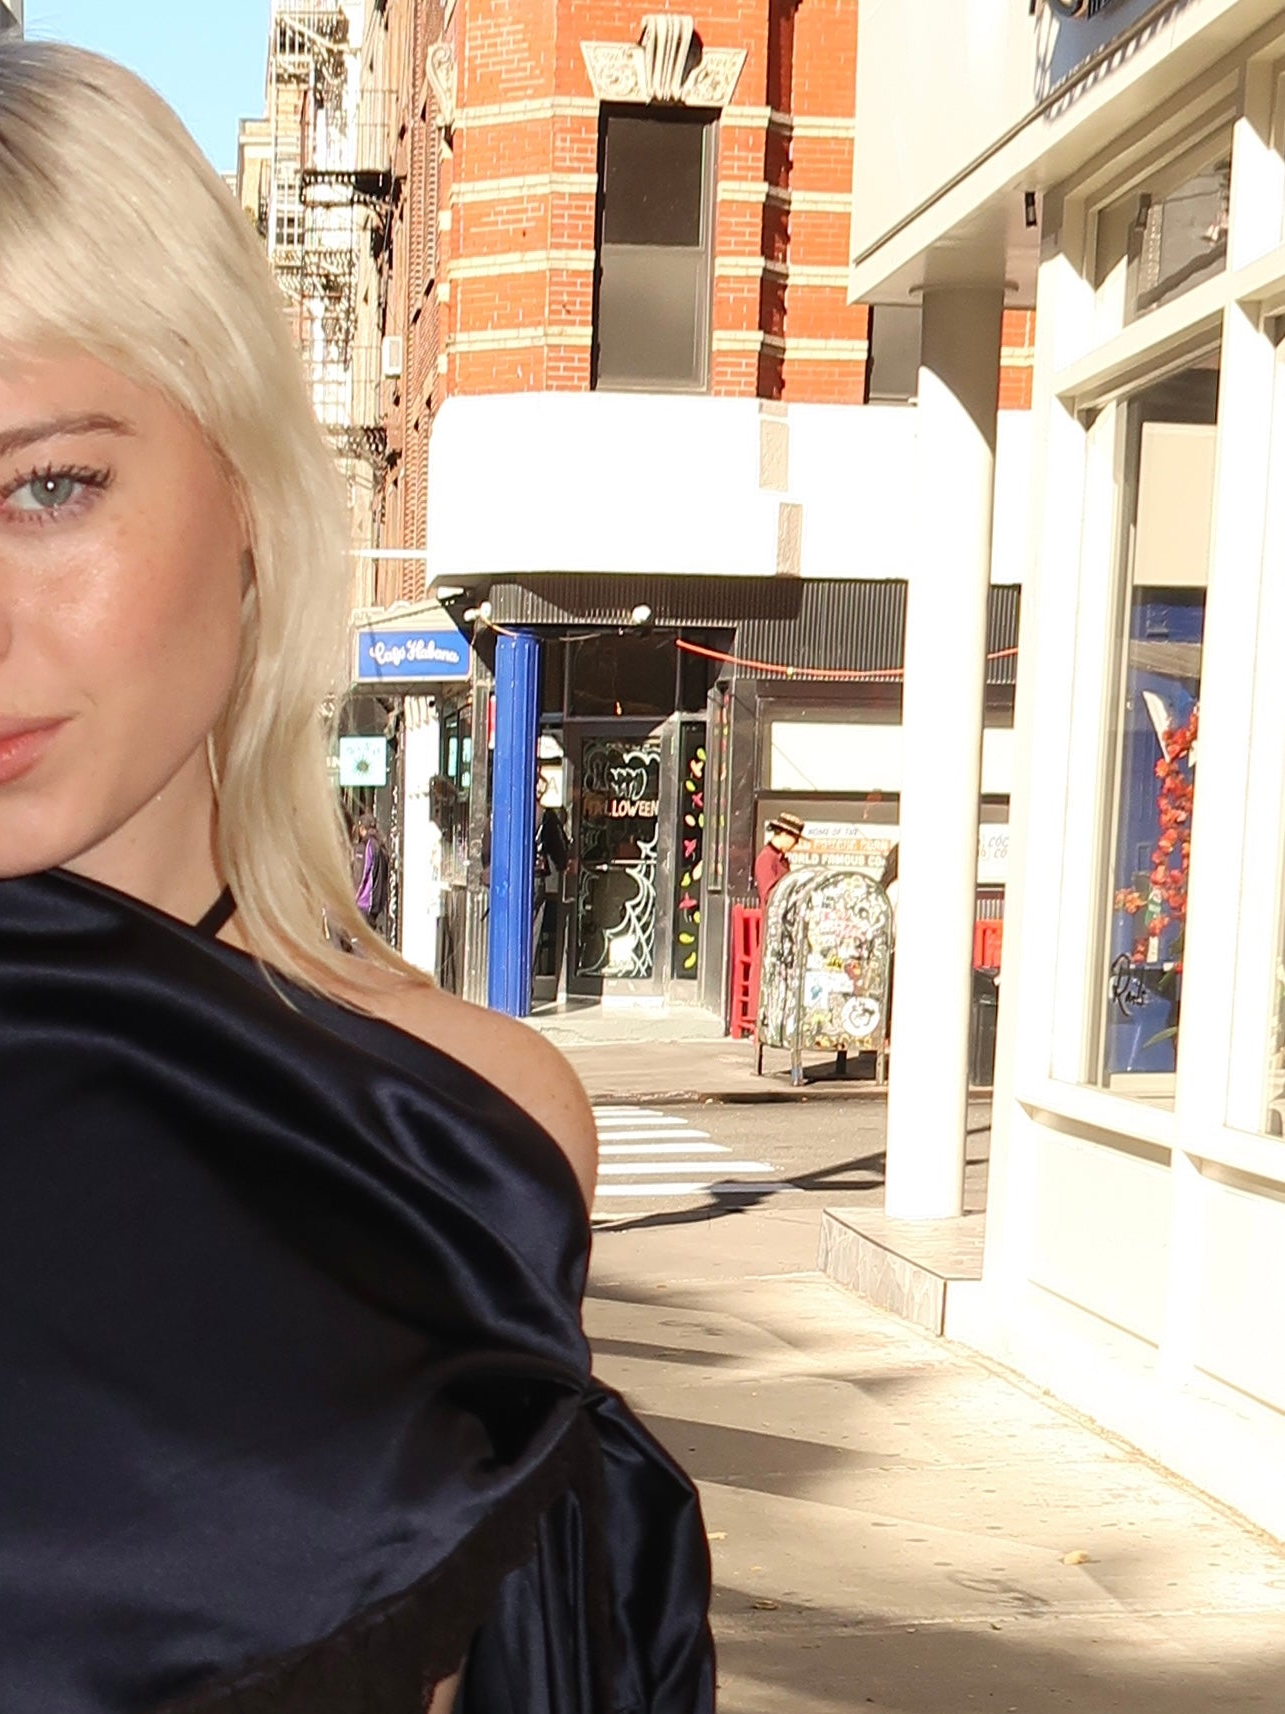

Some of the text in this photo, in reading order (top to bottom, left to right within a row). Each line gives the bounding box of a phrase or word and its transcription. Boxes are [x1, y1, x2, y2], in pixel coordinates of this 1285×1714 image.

[405, 638, 460, 664] Habana
[821, 853, 865, 866] FAMOUS
[868, 855, 886, 868] CO
